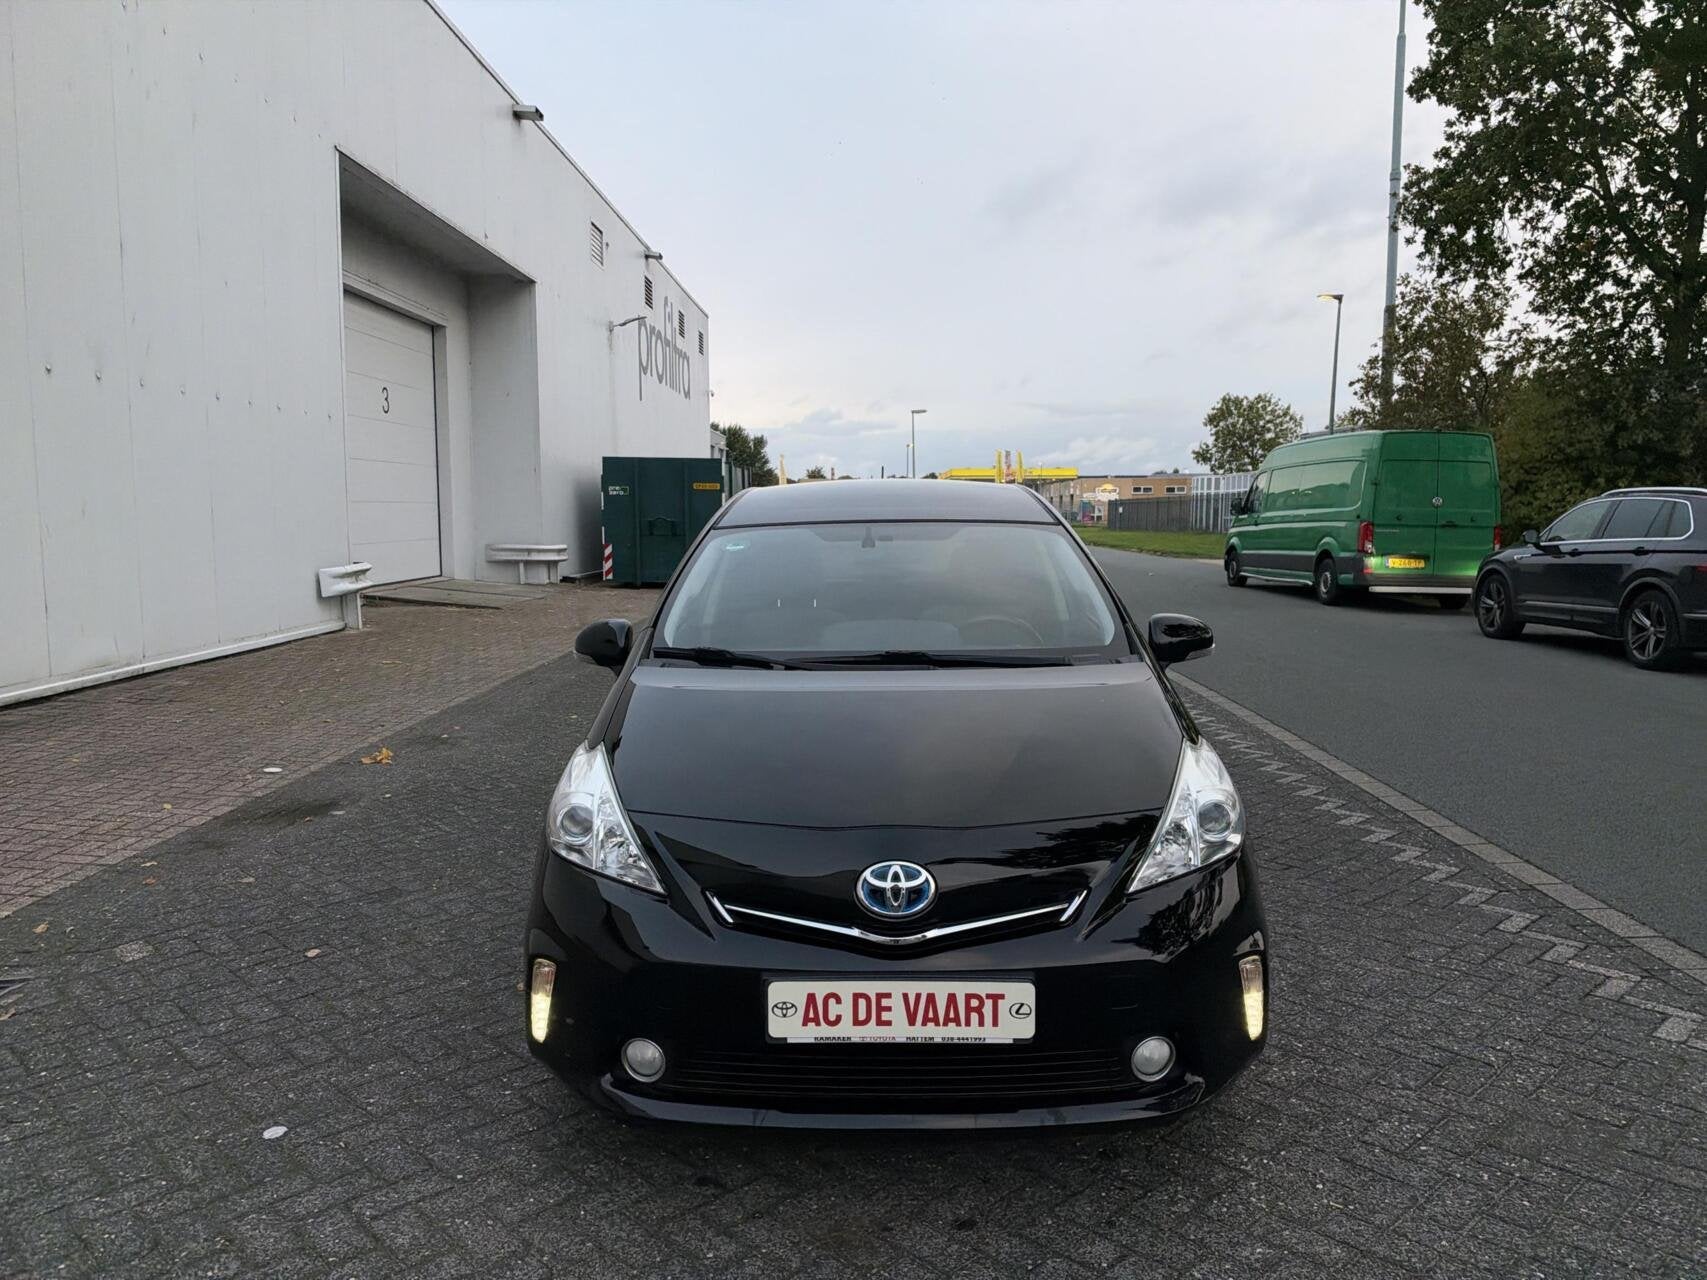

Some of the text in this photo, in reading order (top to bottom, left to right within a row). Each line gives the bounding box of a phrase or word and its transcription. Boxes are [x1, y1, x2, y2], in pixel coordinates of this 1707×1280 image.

[638, 296, 690, 401] profiltra
[382, 387, 390, 414] 3
[802, 992, 1005, 1027] AC DE VAART
